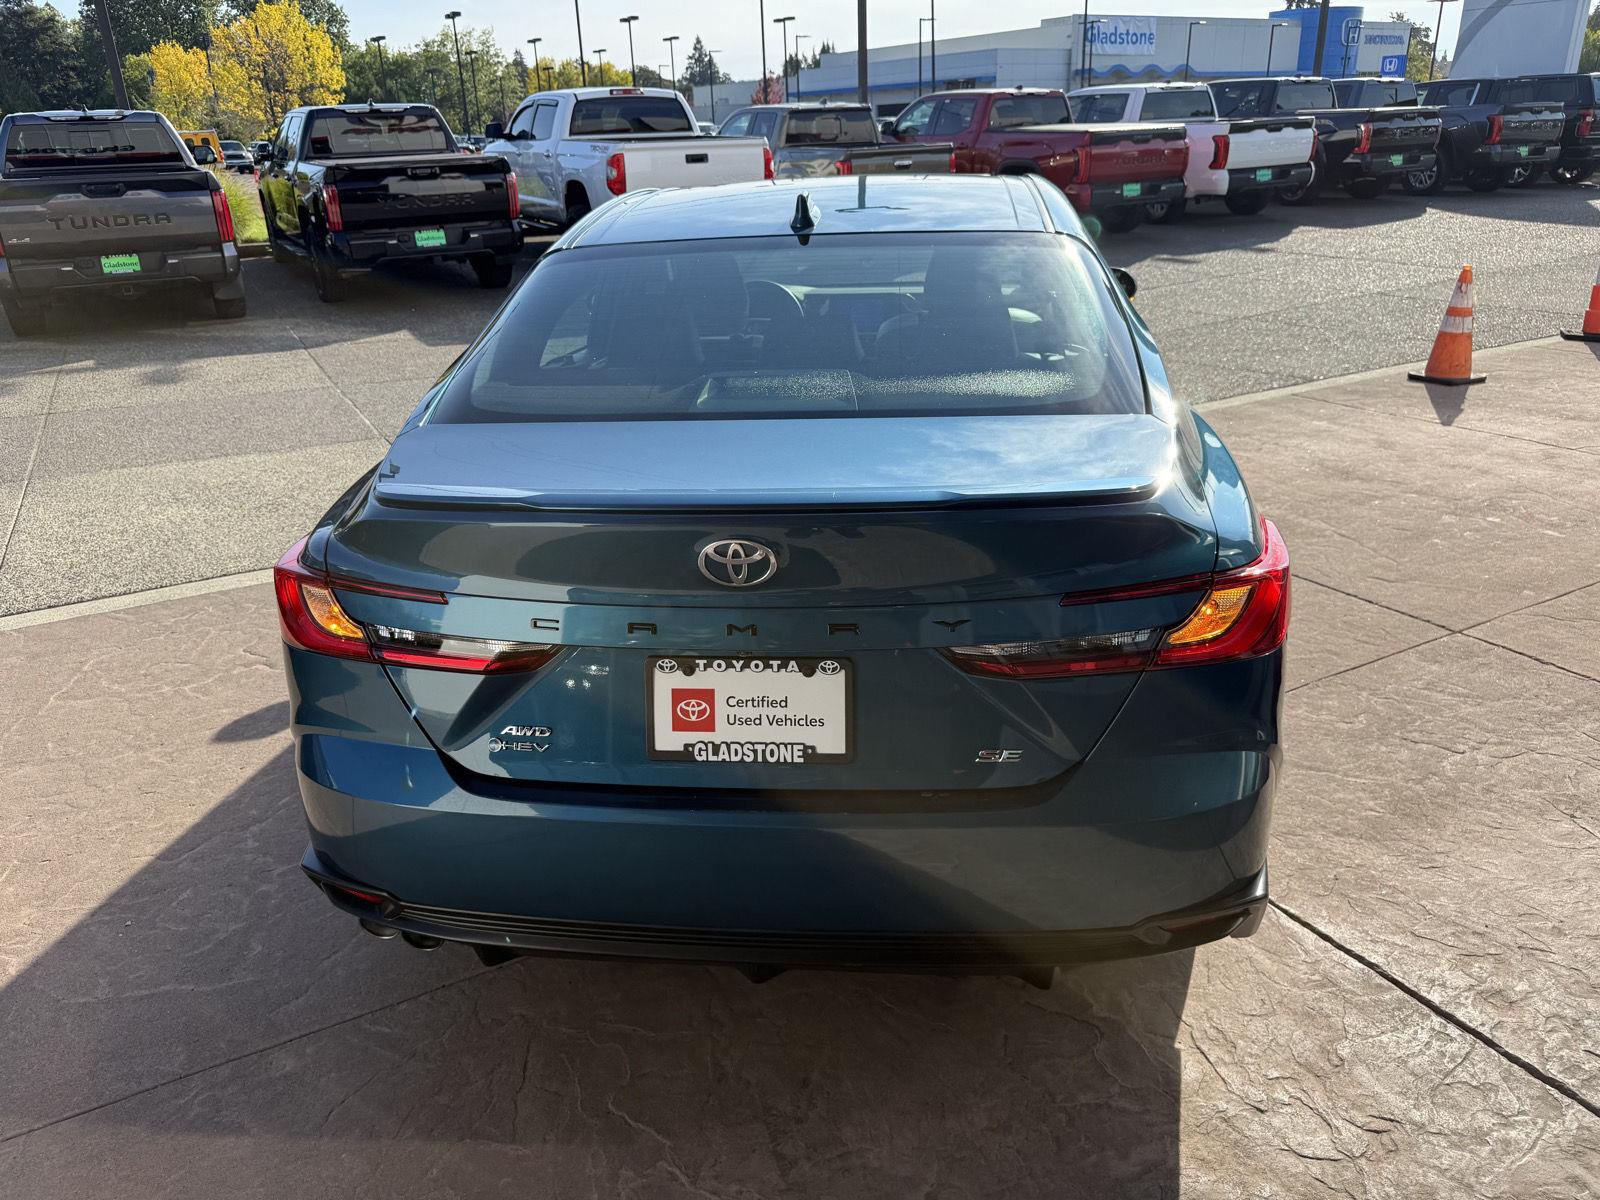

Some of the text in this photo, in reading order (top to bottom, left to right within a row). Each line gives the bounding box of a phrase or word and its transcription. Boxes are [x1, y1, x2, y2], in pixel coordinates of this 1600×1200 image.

[1086, 25, 1155, 45] Gladstone
[1364, 34, 1404, 45] HONDA
[48, 212, 172, 230] TUNDRA
[103, 261, 139, 269] Gladstone
[695, 659, 800, 672] TOYOTA
[726, 696, 788, 708] Certified
[726, 714, 825, 727] Used Vehicles
[500, 725, 552, 737] AWD
[501, 741, 551, 752] HEV
[693, 741, 804, 763] GLADSTONE
[975, 749, 1024, 763] SE
